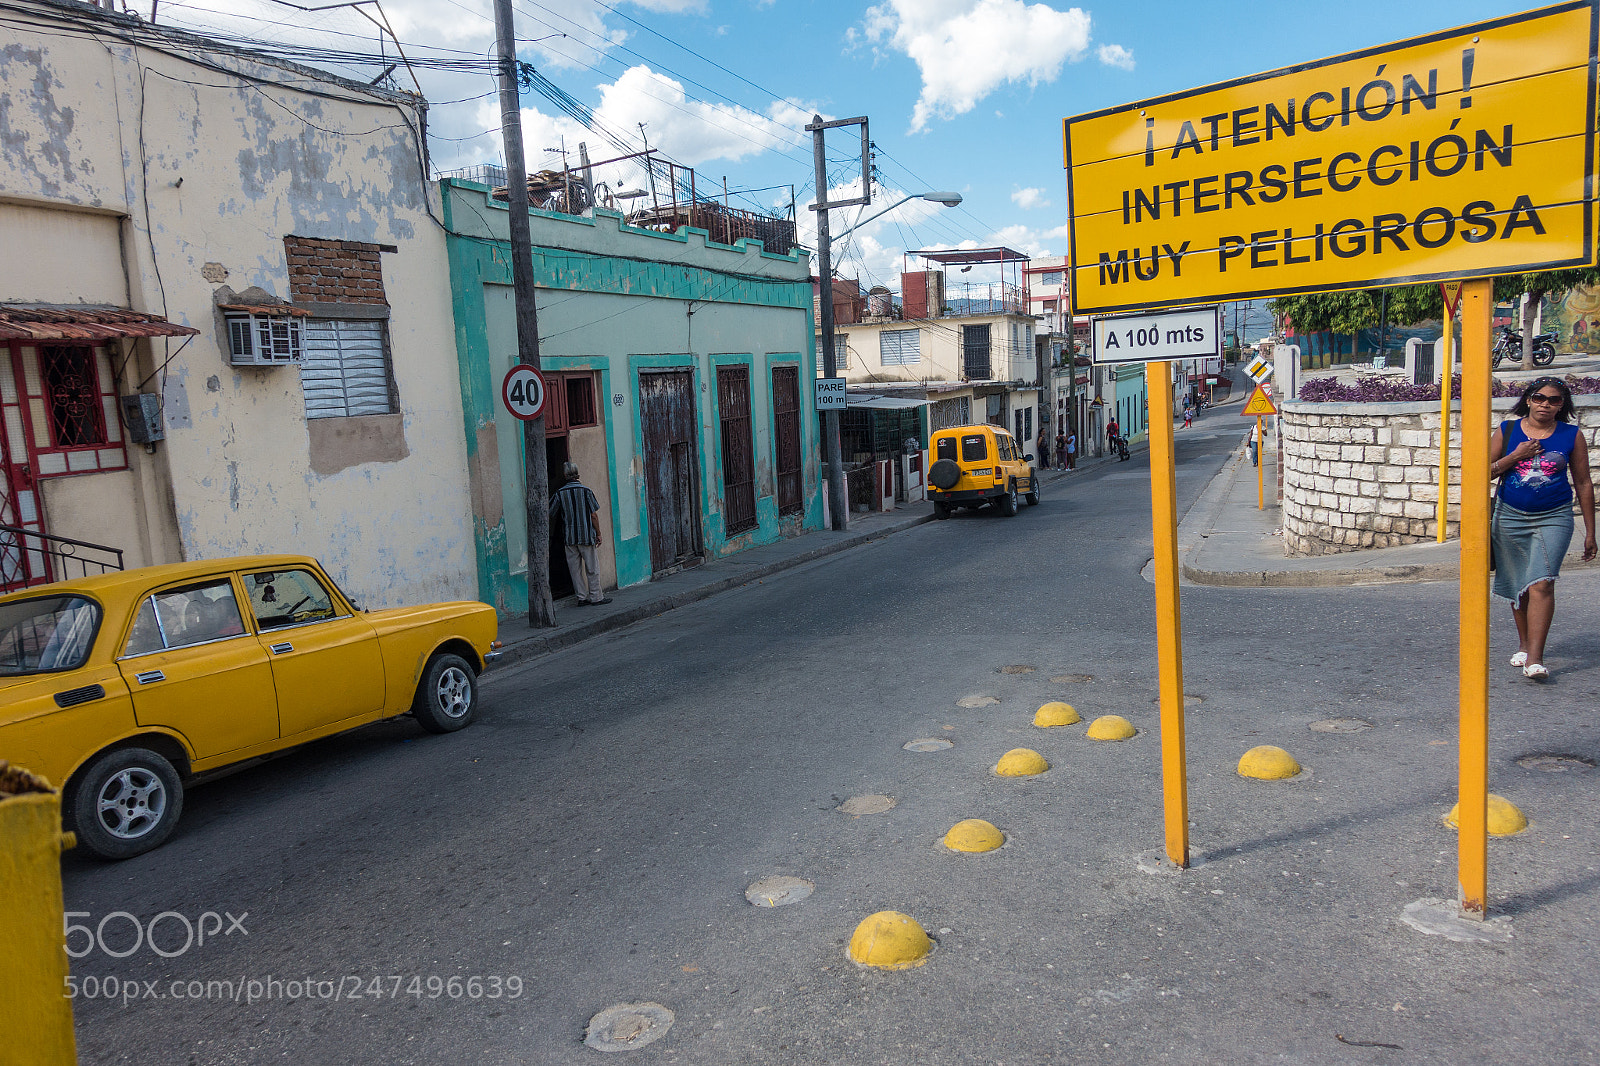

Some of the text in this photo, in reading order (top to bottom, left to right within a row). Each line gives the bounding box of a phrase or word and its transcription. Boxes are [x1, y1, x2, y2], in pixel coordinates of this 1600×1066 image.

[1122, 118, 1513, 225] INTERSECCIÓN
[1099, 194, 1547, 286] MUY PELIGROSA
[1105, 324, 1205, 349] A 100 mts
[510, 378, 539, 406] 40
[818, 383, 844, 392] PARE
[818, 396, 833, 404] 100
